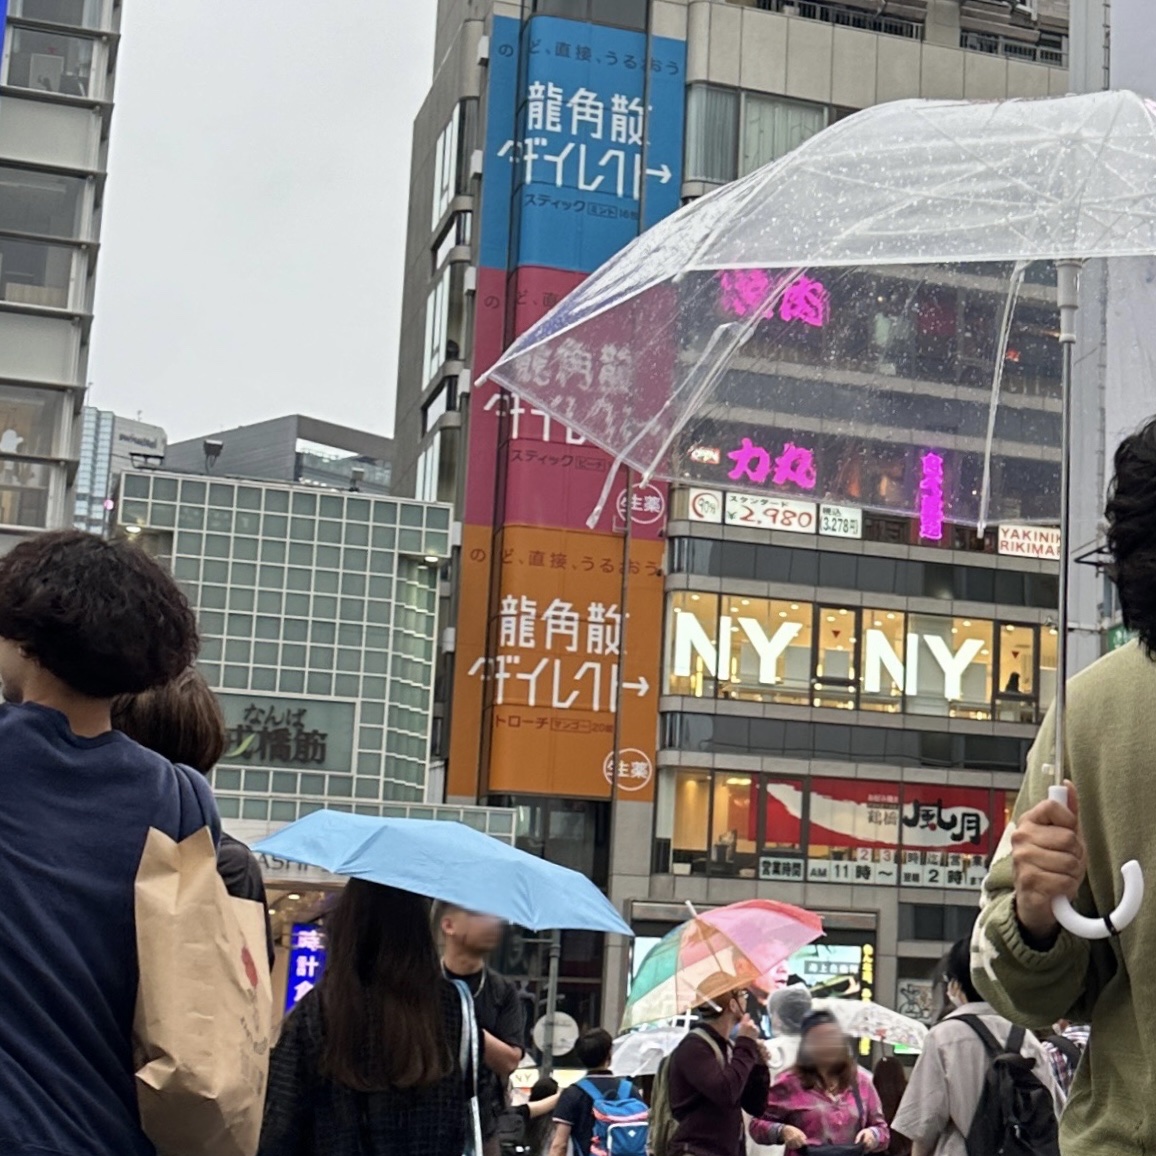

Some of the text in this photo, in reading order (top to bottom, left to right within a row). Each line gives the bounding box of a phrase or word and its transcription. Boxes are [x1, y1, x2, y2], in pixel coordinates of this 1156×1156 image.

[528, 81, 652, 146] 龍角散
[727, 437, 818, 490] 力丸
[500, 594, 631, 656] 龍角散
[674, 612, 985, 700] NY NY
[243, 703, 308, 729] なんば
[496, 714, 549, 730] トローチ
